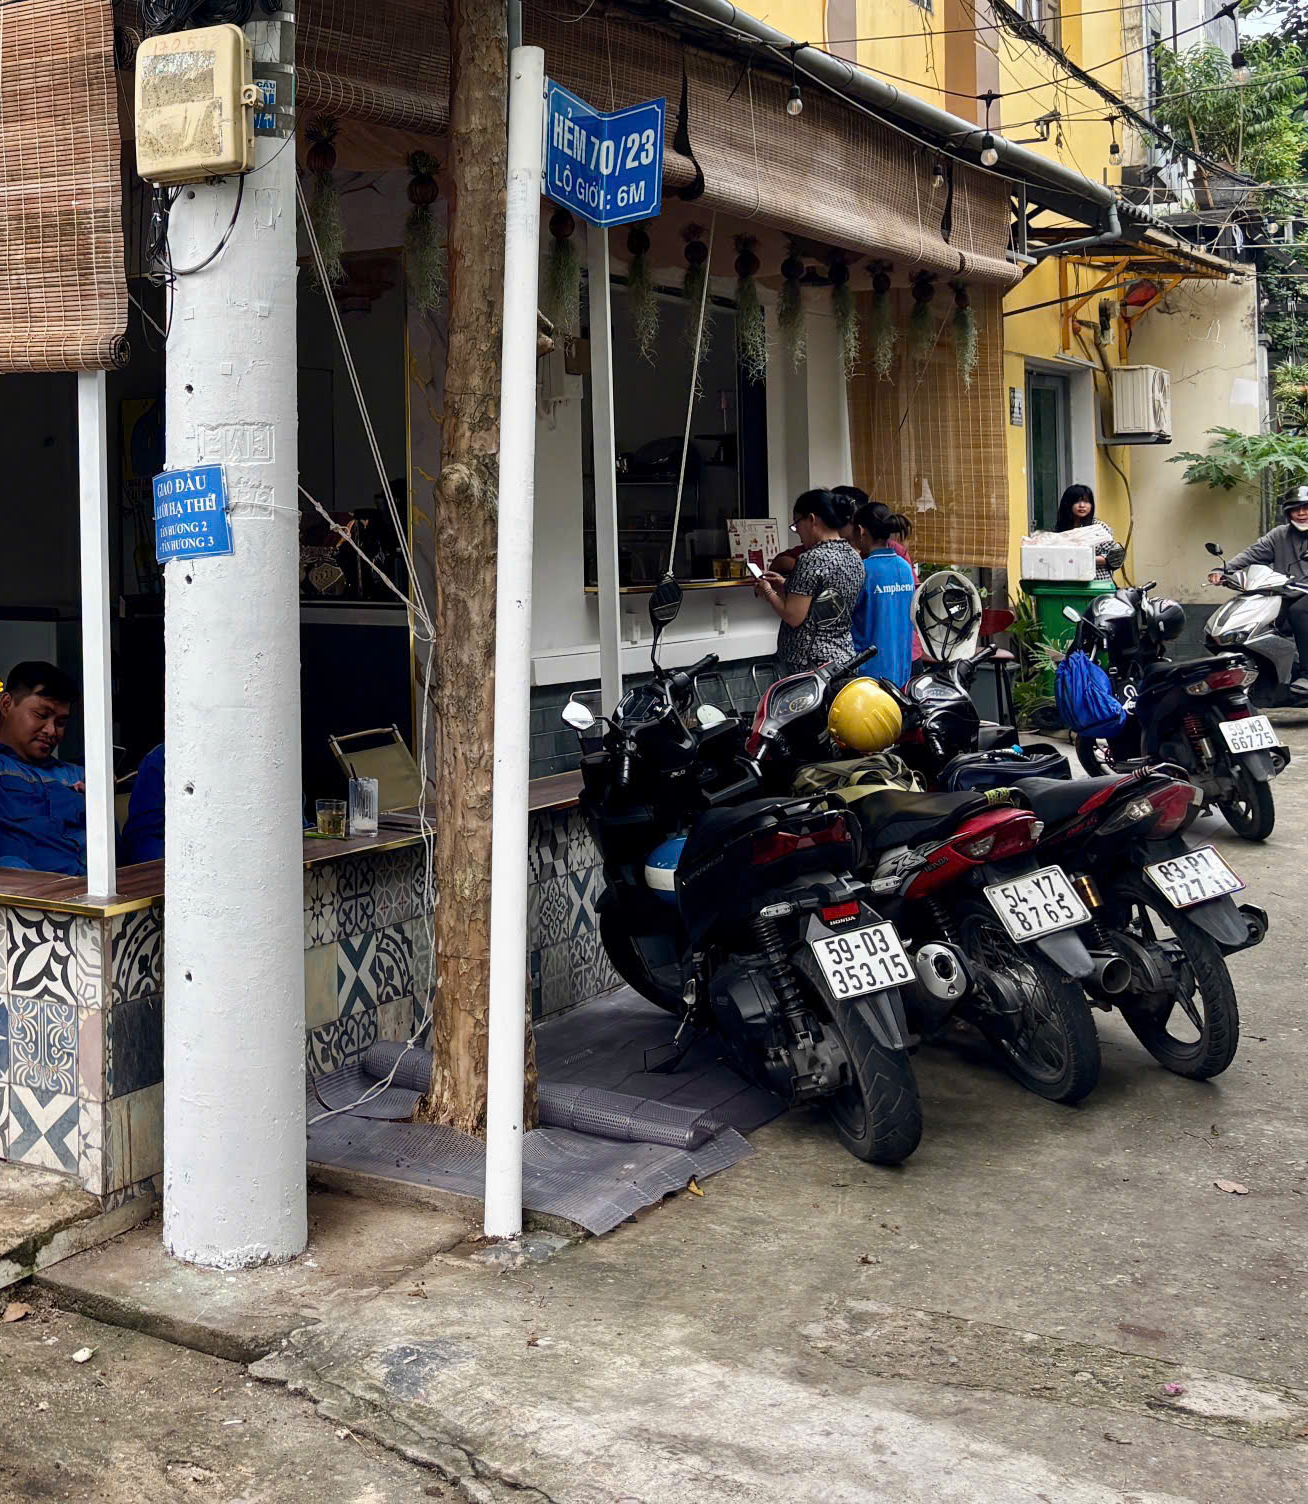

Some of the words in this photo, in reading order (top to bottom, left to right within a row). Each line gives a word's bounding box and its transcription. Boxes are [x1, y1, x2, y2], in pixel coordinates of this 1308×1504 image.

[553, 107, 587, 165] HẺM
[590, 129, 655, 177] 70/23
[555, 164, 573, 196] LỘ
[617, 180, 645, 207] 6M
[157, 480, 173, 498] GIAO
[201, 521, 208, 532] 2
[207, 536, 215, 547] 3
[1231, 731, 1274, 751] 667.75
[829, 915, 856, 926] HONDA
[1014, 901, 1075, 932] 8765
[825, 928, 891, 966] 59-D3
[832, 953, 909, 995] 353.15
